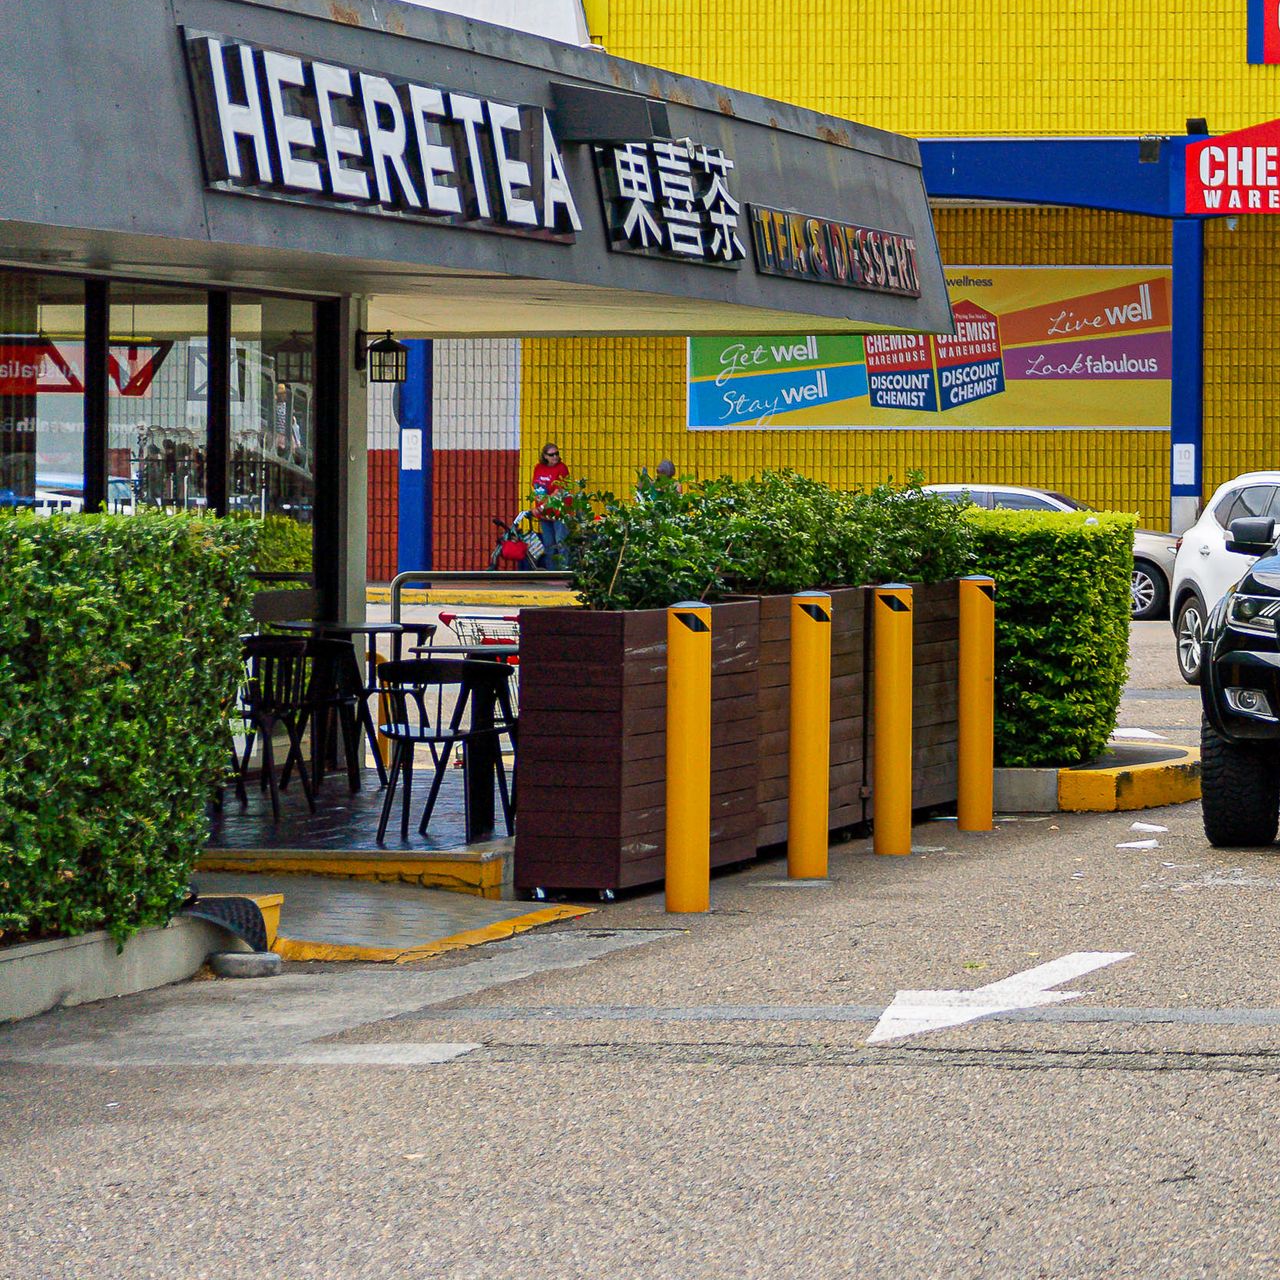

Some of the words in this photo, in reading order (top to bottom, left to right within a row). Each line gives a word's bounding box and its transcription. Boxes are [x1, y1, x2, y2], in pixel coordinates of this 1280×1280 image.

[208, 37, 583, 231] HEERETEA
[752, 208, 806, 272] TEA
[825, 223, 920, 290] DESSERT
[946, 275, 993, 287] wellness
[1047, 310, 1108, 335] Live
[1104, 283, 1152, 325] well
[715, 343, 768, 387] Get
[770, 335, 818, 363] well
[868, 350, 926, 366] WAREHOUSE
[938, 342, 997, 359] WAREHOUSE
[941, 362, 1000, 388] DISCOUNT
[1025, 353, 1086, 376] Look
[1085, 354, 1158, 374] fabulous
[871, 373, 930, 389] DISCOUNT
[950, 377, 997, 404] CHEMIST
[718, 391, 779, 426] Stay
[781, 370, 828, 405] well
[876, 390, 926, 407] CHEMIST
